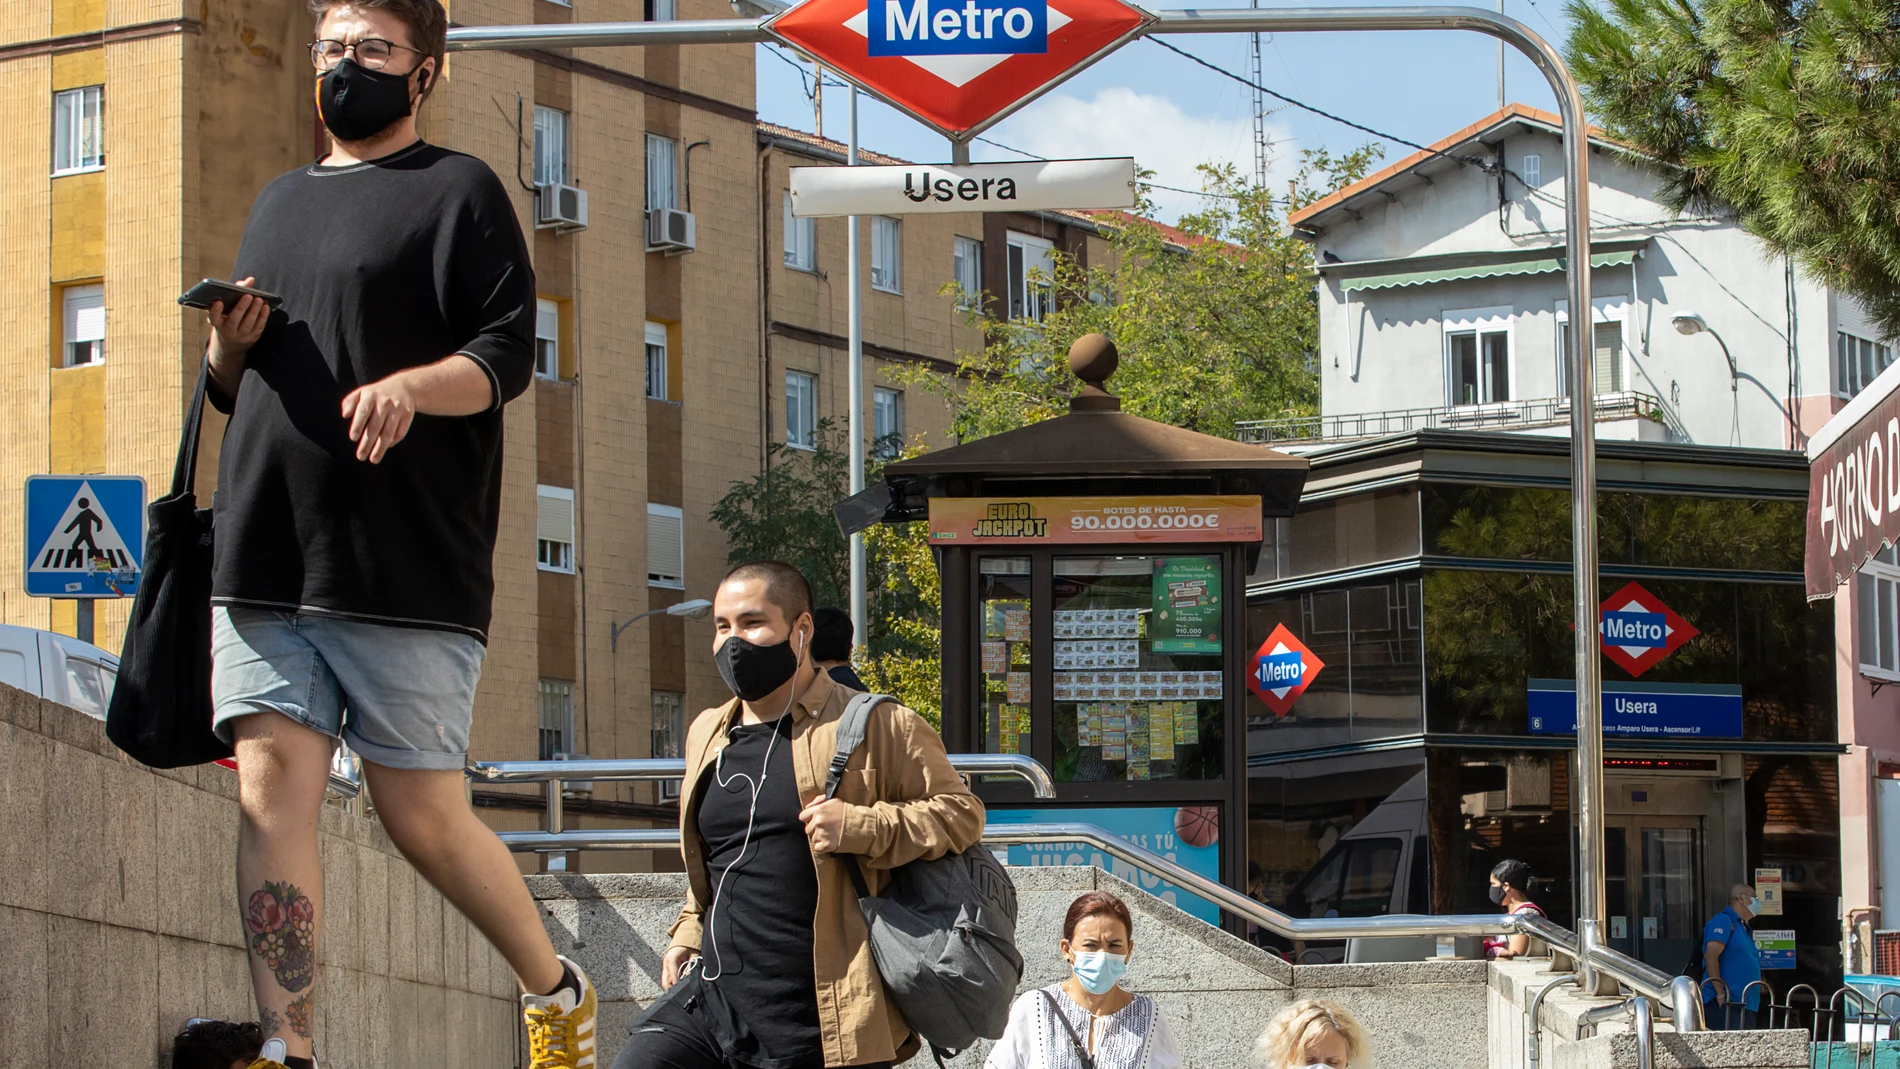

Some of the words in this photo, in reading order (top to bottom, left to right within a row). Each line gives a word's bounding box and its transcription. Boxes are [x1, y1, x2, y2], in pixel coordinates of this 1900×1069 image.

[885, 0, 1034, 41] Metro
[903, 172, 1017, 203] Usera
[1820, 431, 1883, 558] HORNO
[987, 502, 1032, 520] EURO
[1103, 507, 1136, 515] BOTES
[1154, 506, 1186, 514] HASTA
[972, 518, 1047, 537] JACKPOT
[1071, 514, 1219, 530] 90.000.000€
[1606, 618, 1662, 640] Metro
[1262, 661, 1300, 683] Metro
[1615, 698, 1657, 714] Usera
[1534, 719, 1540, 729] 6
[1616, 724, 1641, 734] Amparo
[1641, 725, 1659, 733] Usera
